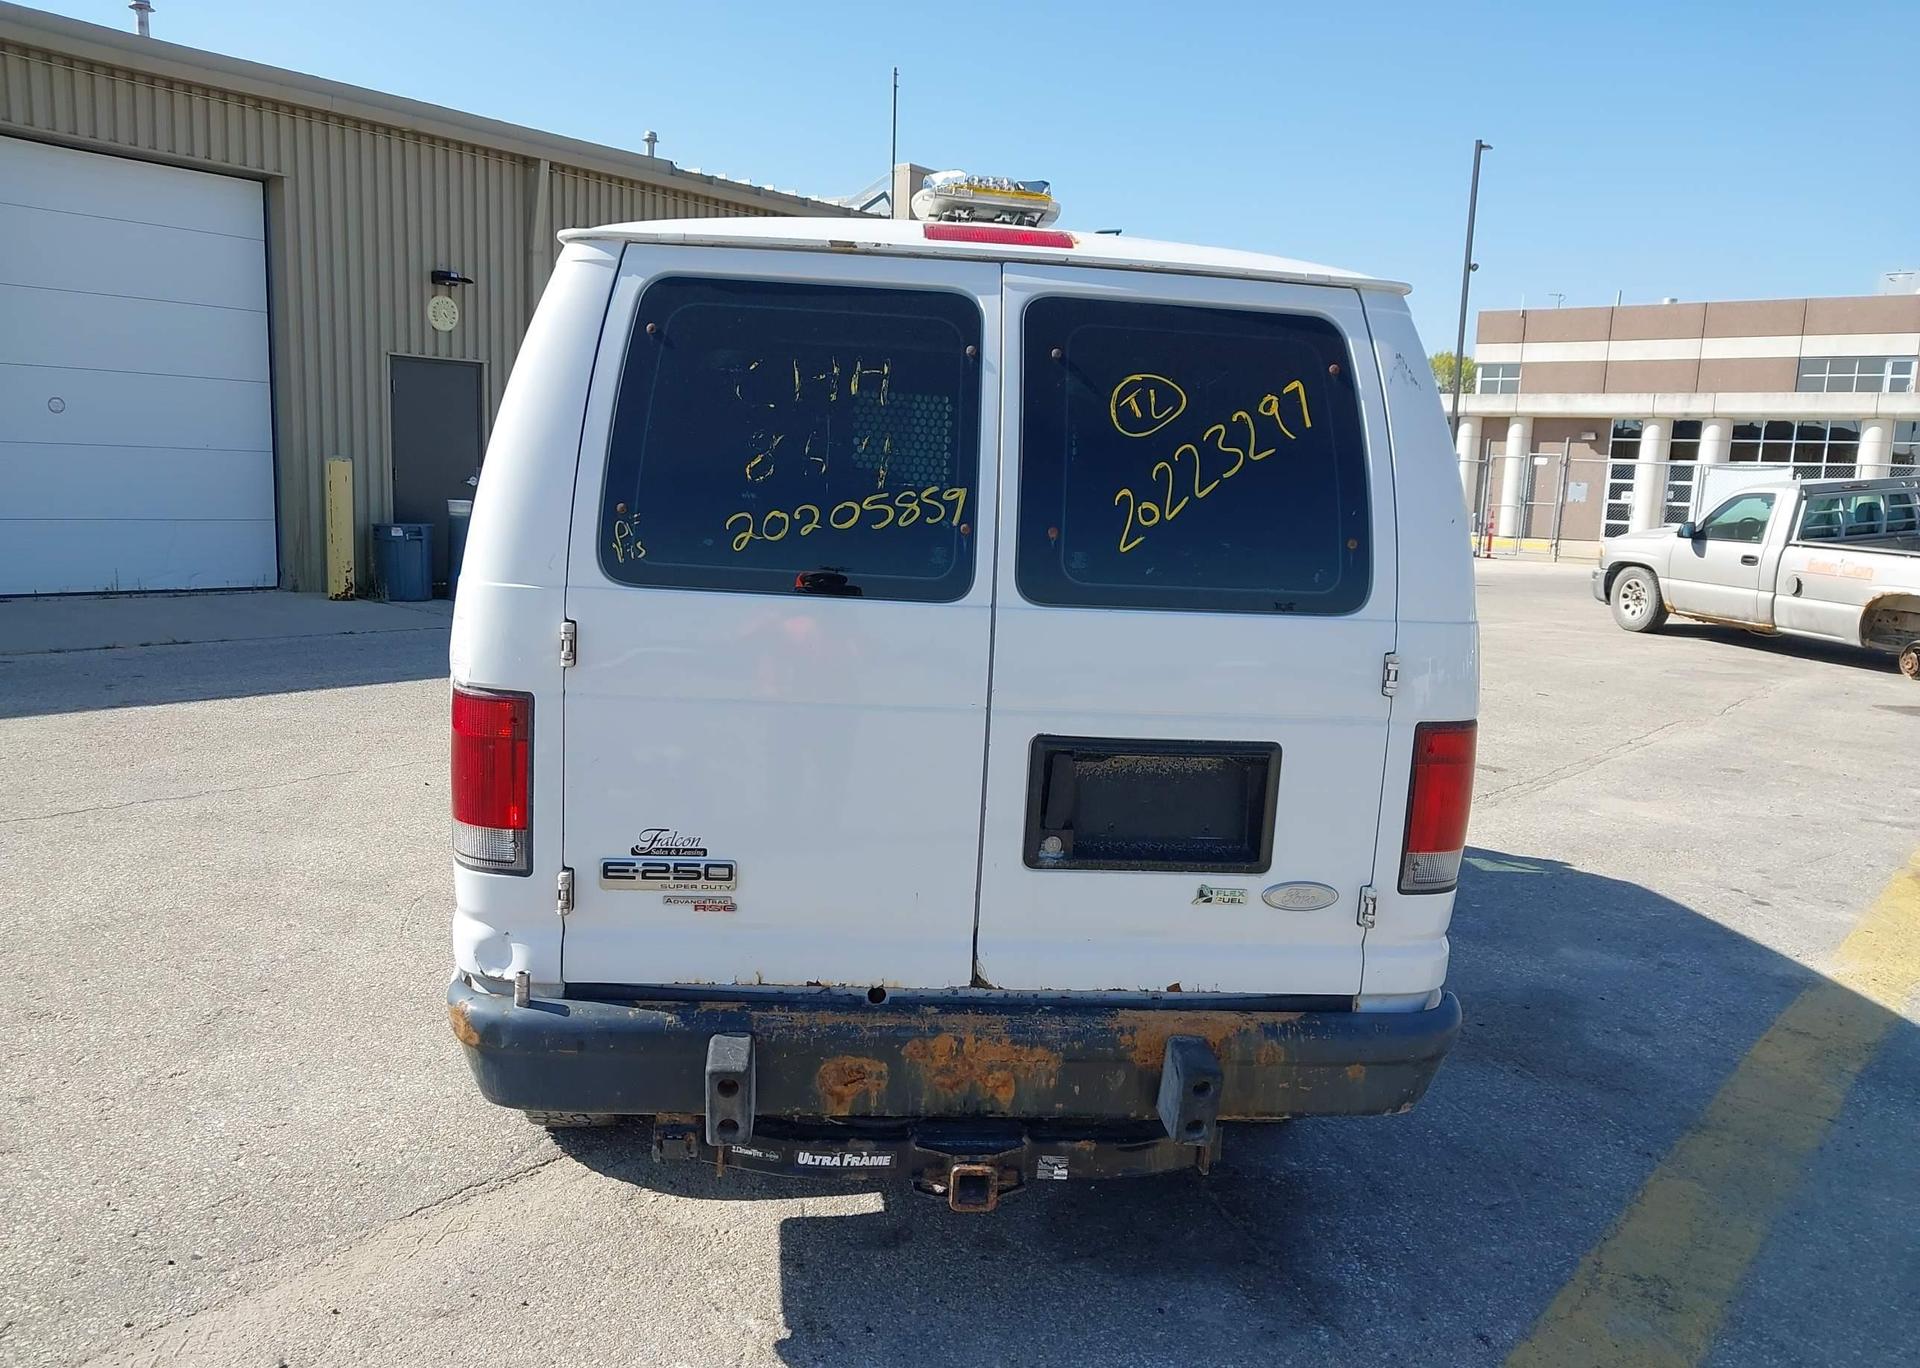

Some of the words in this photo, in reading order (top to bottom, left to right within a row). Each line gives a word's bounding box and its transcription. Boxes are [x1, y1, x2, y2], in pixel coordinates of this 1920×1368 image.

[1120, 388, 1173, 420] TL
[1114, 379, 1313, 553] 20223297
[725, 486, 969, 552] 20205859
[634, 828, 702, 853] Falcon
[650, 848, 668, 856] Sales
[679, 848, 704, 856] Leasing
[700, 883, 732, 891] DUTY
[1216, 889, 1246, 897] FLEX
[1215, 896, 1244, 904] FUEL
[797, 1152, 841, 1166] ULTRA
[842, 1152, 892, 1167] FRAME
